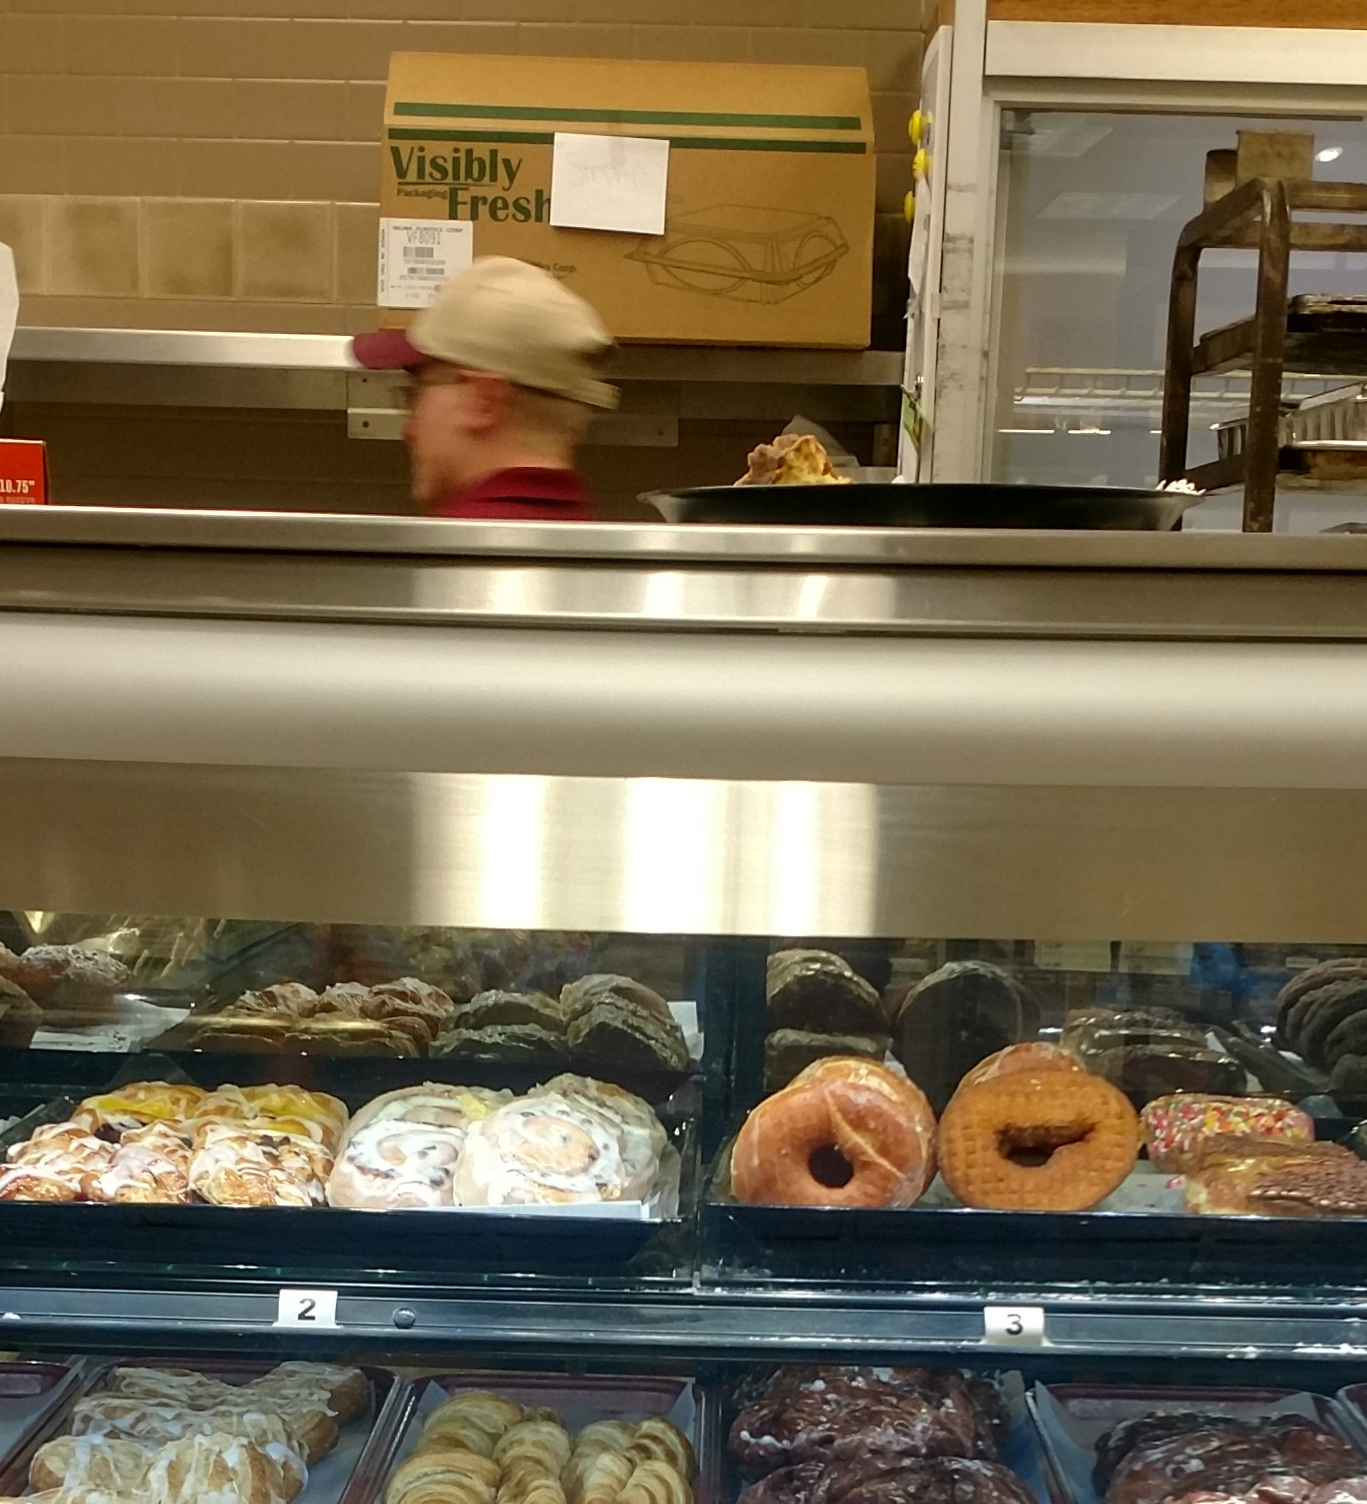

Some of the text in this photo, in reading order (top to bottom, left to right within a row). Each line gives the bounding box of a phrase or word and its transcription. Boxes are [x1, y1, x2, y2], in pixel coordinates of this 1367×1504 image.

[390, 146, 522, 191] Visibly
[448, 187, 551, 222] Fresh
[298, 1299, 316, 1321] 2
[1005, 1312, 1024, 1336] 3
